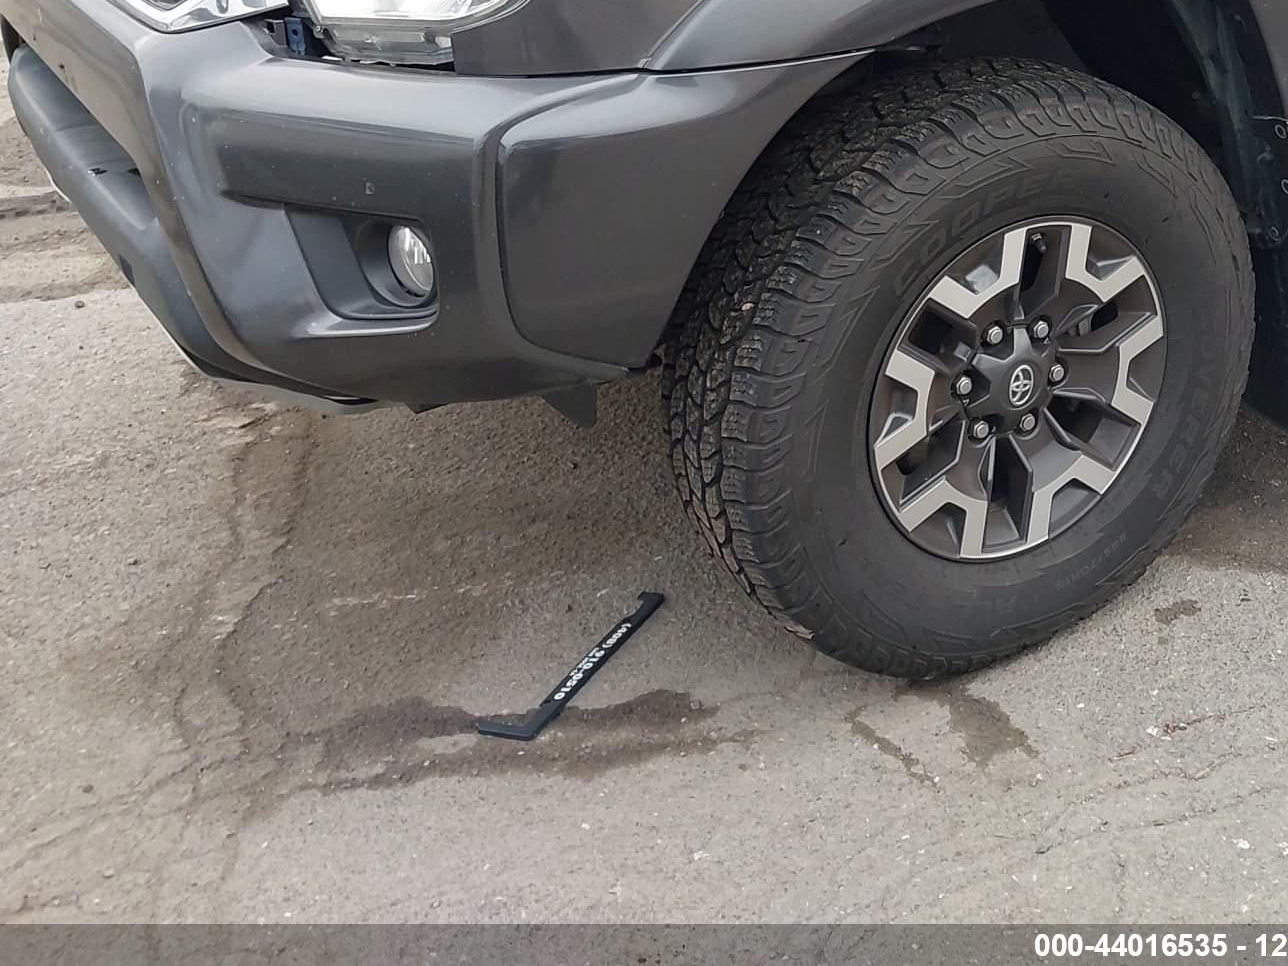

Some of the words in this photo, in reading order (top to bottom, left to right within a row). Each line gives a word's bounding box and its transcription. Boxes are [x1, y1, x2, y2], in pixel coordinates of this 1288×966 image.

[892, 171, 1084, 296] COOPER
[602, 622, 632, 649] (408)
[553, 648, 606, 701] 910-0510
